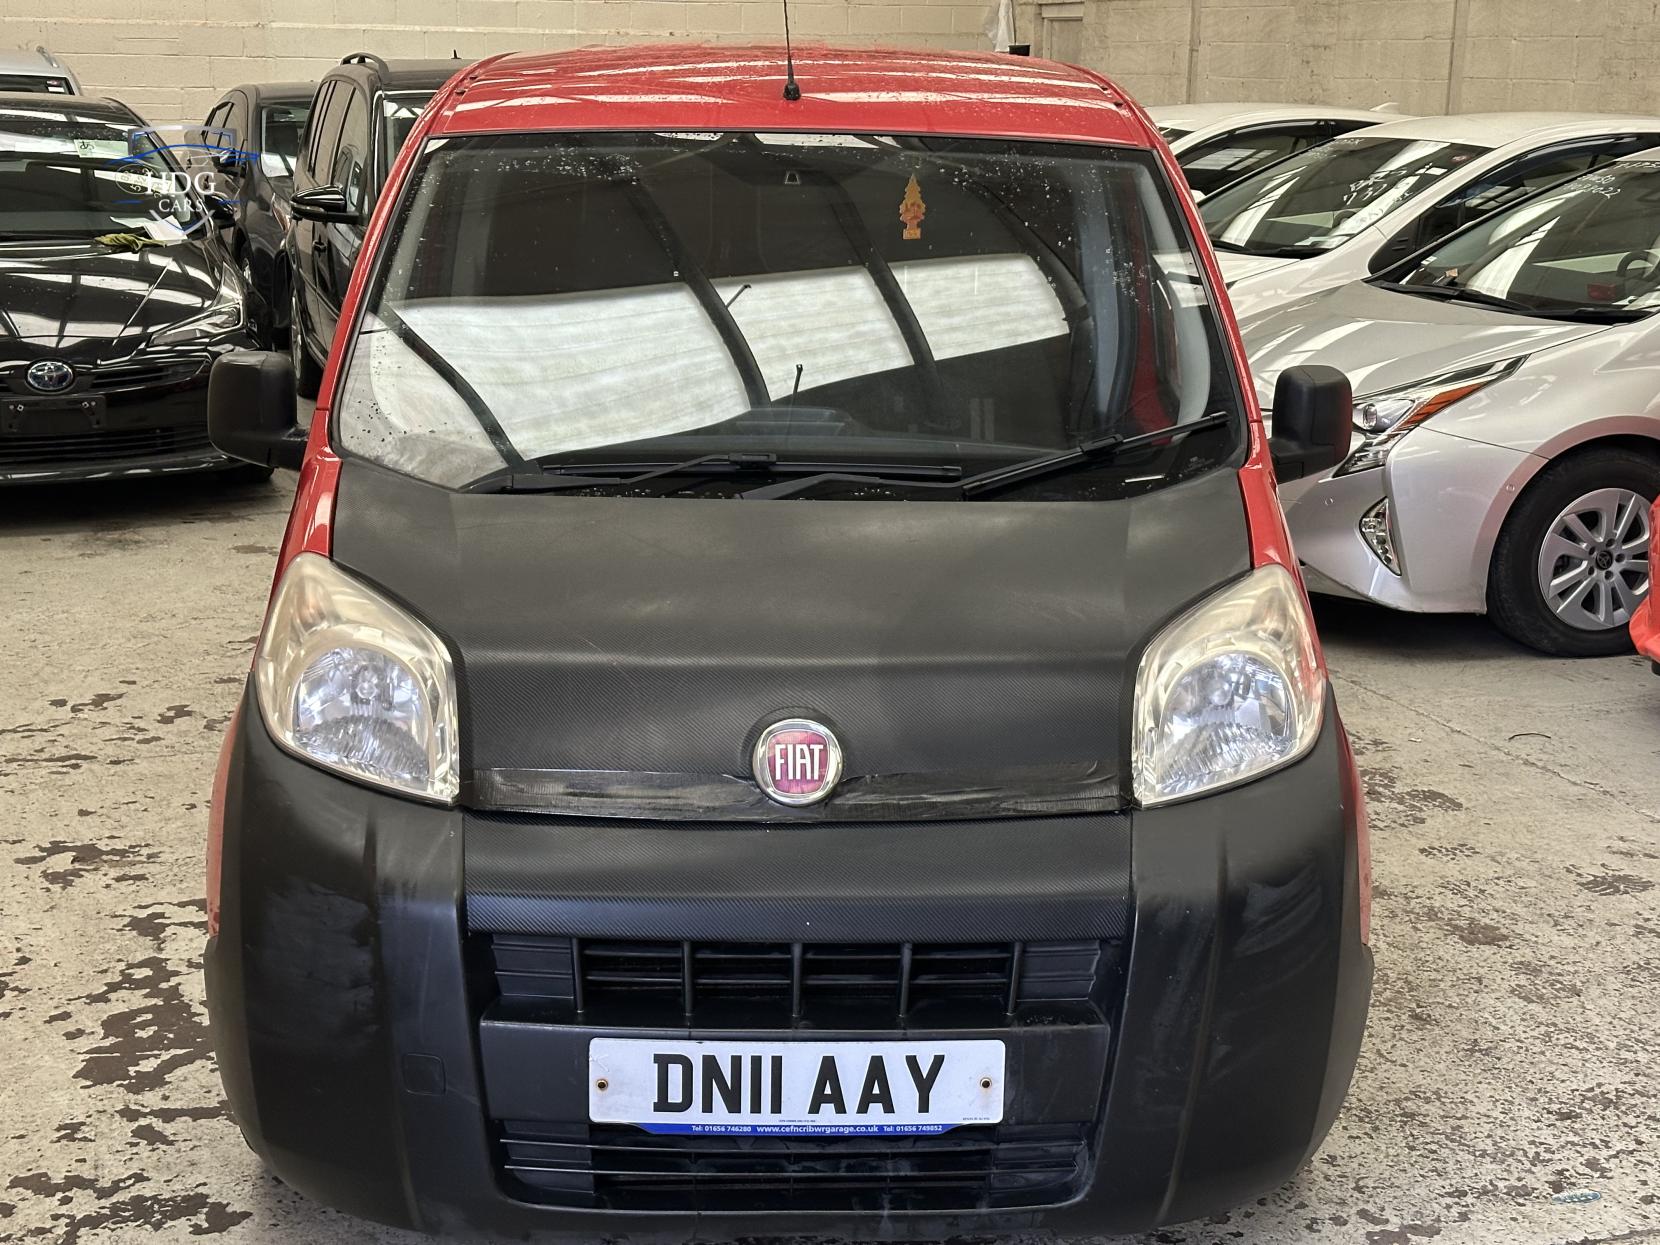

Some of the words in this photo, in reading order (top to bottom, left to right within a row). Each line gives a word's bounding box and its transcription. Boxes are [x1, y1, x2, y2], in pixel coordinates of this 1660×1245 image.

[774, 743, 823, 780] FIAT
[653, 1053, 782, 1113] DN11
[807, 1054, 945, 1114] AAY
[691, 1124, 703, 1132] Tel:
[704, 1124, 726, 1132] 01656
[756, 1124, 879, 1134] www.cefncribwrgarage.co.uk
[895, 1124, 917, 1132] 01656
